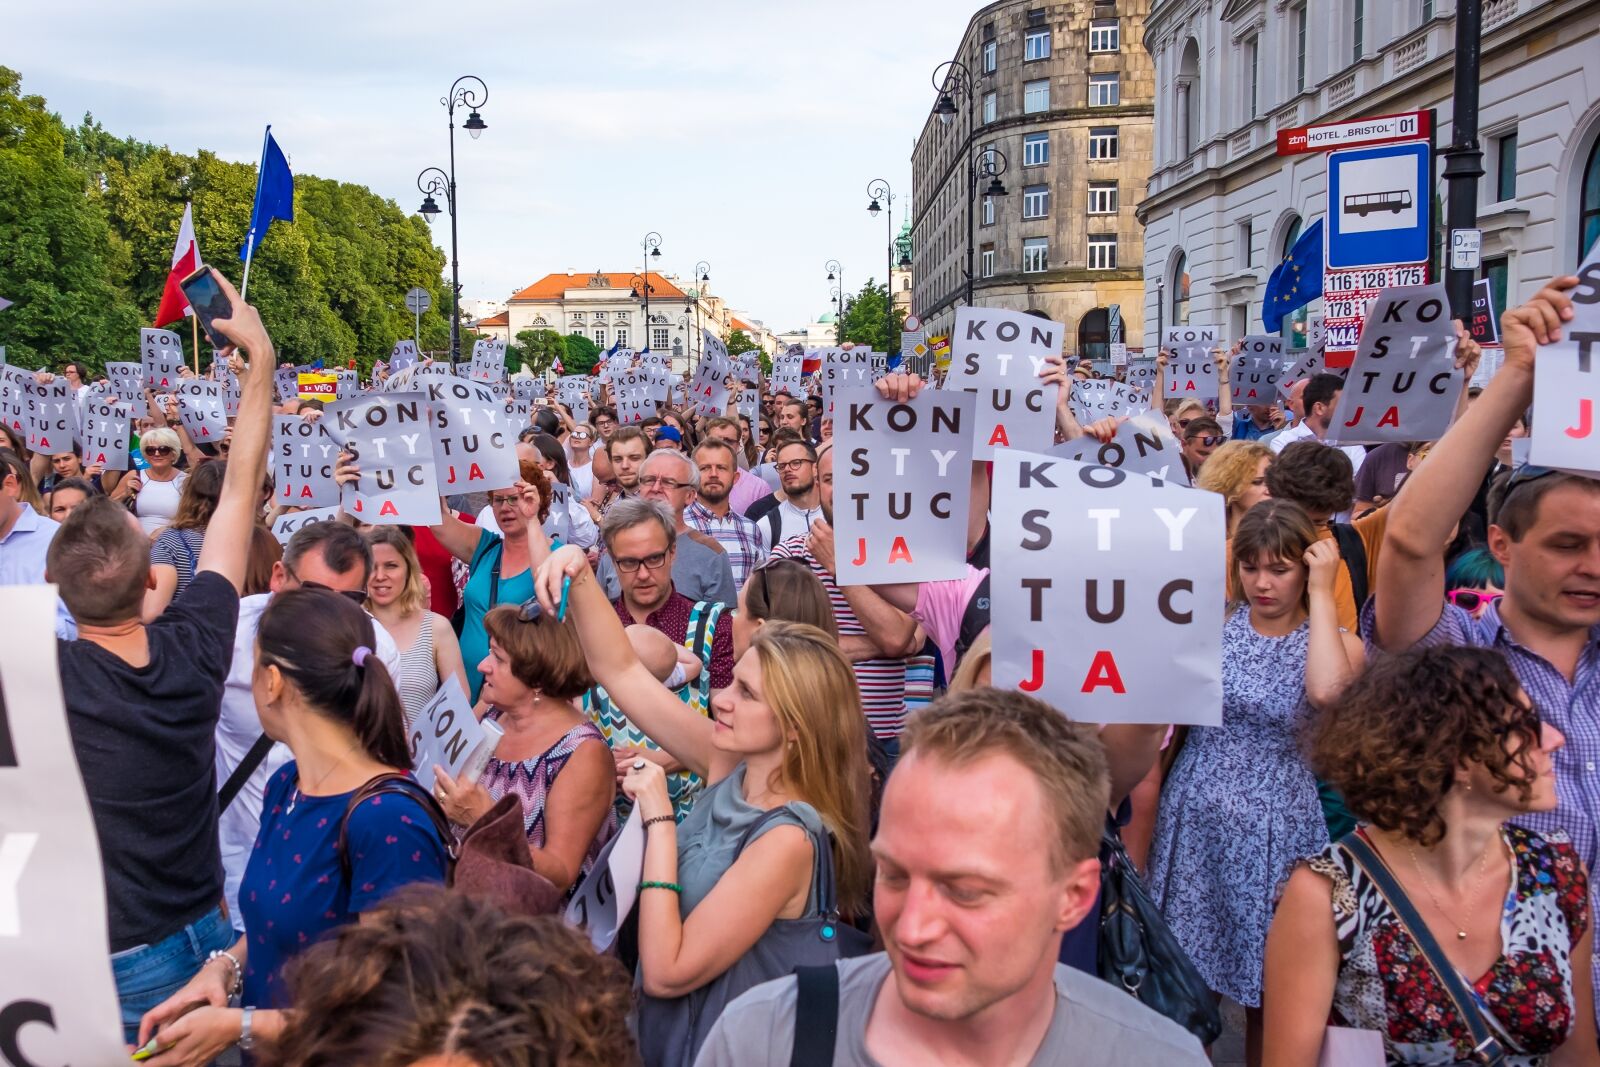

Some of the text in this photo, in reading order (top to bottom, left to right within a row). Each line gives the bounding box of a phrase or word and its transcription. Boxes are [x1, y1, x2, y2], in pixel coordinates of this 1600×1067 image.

[1400, 118, 1414, 133] 01
[1288, 135, 1306, 145] ztm
[1308, 132, 1340, 141] HOTEL
[1454, 235, 1463, 246] D
[1329, 269, 1420, 291] 116 128 175
[1328, 300, 1367, 317] 178 1
[1382, 299, 1442, 323] KO
[147, 334, 180, 347] KON
[966, 320, 1052, 348] KON
[1170, 331, 1213, 342] KON
[1327, 327, 1356, 346] N44
[394, 345, 413, 355] ON
[478, 342, 503, 350] KON
[705, 336, 727, 356] KON
[1170, 347, 1212, 358] STY
[1240, 341, 1281, 353] KON
[148, 349, 182, 360] STY
[477, 351, 502, 360] STY
[643, 357, 667, 365] KON
[827, 353, 866, 363] KON
[149, 362, 183, 375] TUC
[395, 359, 413, 368] TY
[476, 360, 500, 370] TUC
[964, 353, 1046, 376] STY
[1171, 364, 1211, 374] TUC
[1238, 357, 1279, 369] STY
[111, 366, 142, 376] KON
[702, 366, 732, 385] TUC
[828, 369, 866, 380] STY
[115, 379, 144, 388] STY
[149, 376, 169, 386] JA
[226, 379, 240, 387] ST
[618, 374, 648, 385] KON
[1073, 379, 1105, 390] KON
[1236, 372, 1276, 384] TUC
[1362, 372, 1452, 394] TUC
[24, 384, 66, 397] KON
[177, 384, 217, 397] KON
[283, 382, 297, 391] ST
[314, 383, 332, 392] VETO
[620, 386, 648, 398] STY
[695, 383, 712, 397] JA
[1171, 380, 1196, 391] JA
[3, 387, 21, 400] ST
[428, 383, 493, 403] KON
[1116, 388, 1149, 403] KON
[1233, 388, 1257, 398] JA
[3, 402, 20, 415] TU
[29, 400, 66, 414] STY
[179, 399, 217, 409] STY
[505, 405, 526, 413] ON
[621, 399, 650, 410] TUC
[701, 405, 716, 413] JA
[1111, 401, 1146, 415] STY
[88, 404, 126, 418] KON
[184, 411, 219, 423] TUC
[337, 402, 418, 430] KON
[624, 413, 641, 422] JA
[1345, 406, 1399, 428] JA
[30, 416, 66, 431] TUC
[437, 408, 497, 428] STY
[506, 419, 526, 427] TY
[850, 404, 960, 434] KON
[88, 420, 125, 433] STY
[192, 426, 209, 437] JA
[30, 434, 50, 448] JA
[88, 435, 123, 449] TUC
[344, 433, 420, 461] STY
[441, 433, 504, 455] TUC
[87, 450, 106, 463] JA
[283, 443, 332, 458] STY
[850, 448, 957, 476] STY
[284, 464, 331, 478] TUC
[447, 463, 485, 483] JA
[284, 484, 312, 497] JA
[354, 500, 399, 516] JA
[851, 492, 951, 520] TUC
[1020, 508, 1199, 551] STY
[852, 536, 913, 566] JA
[1021, 578, 1193, 624] TUC
[1018, 649, 1126, 693] JA
[427, 691, 468, 766] KON
